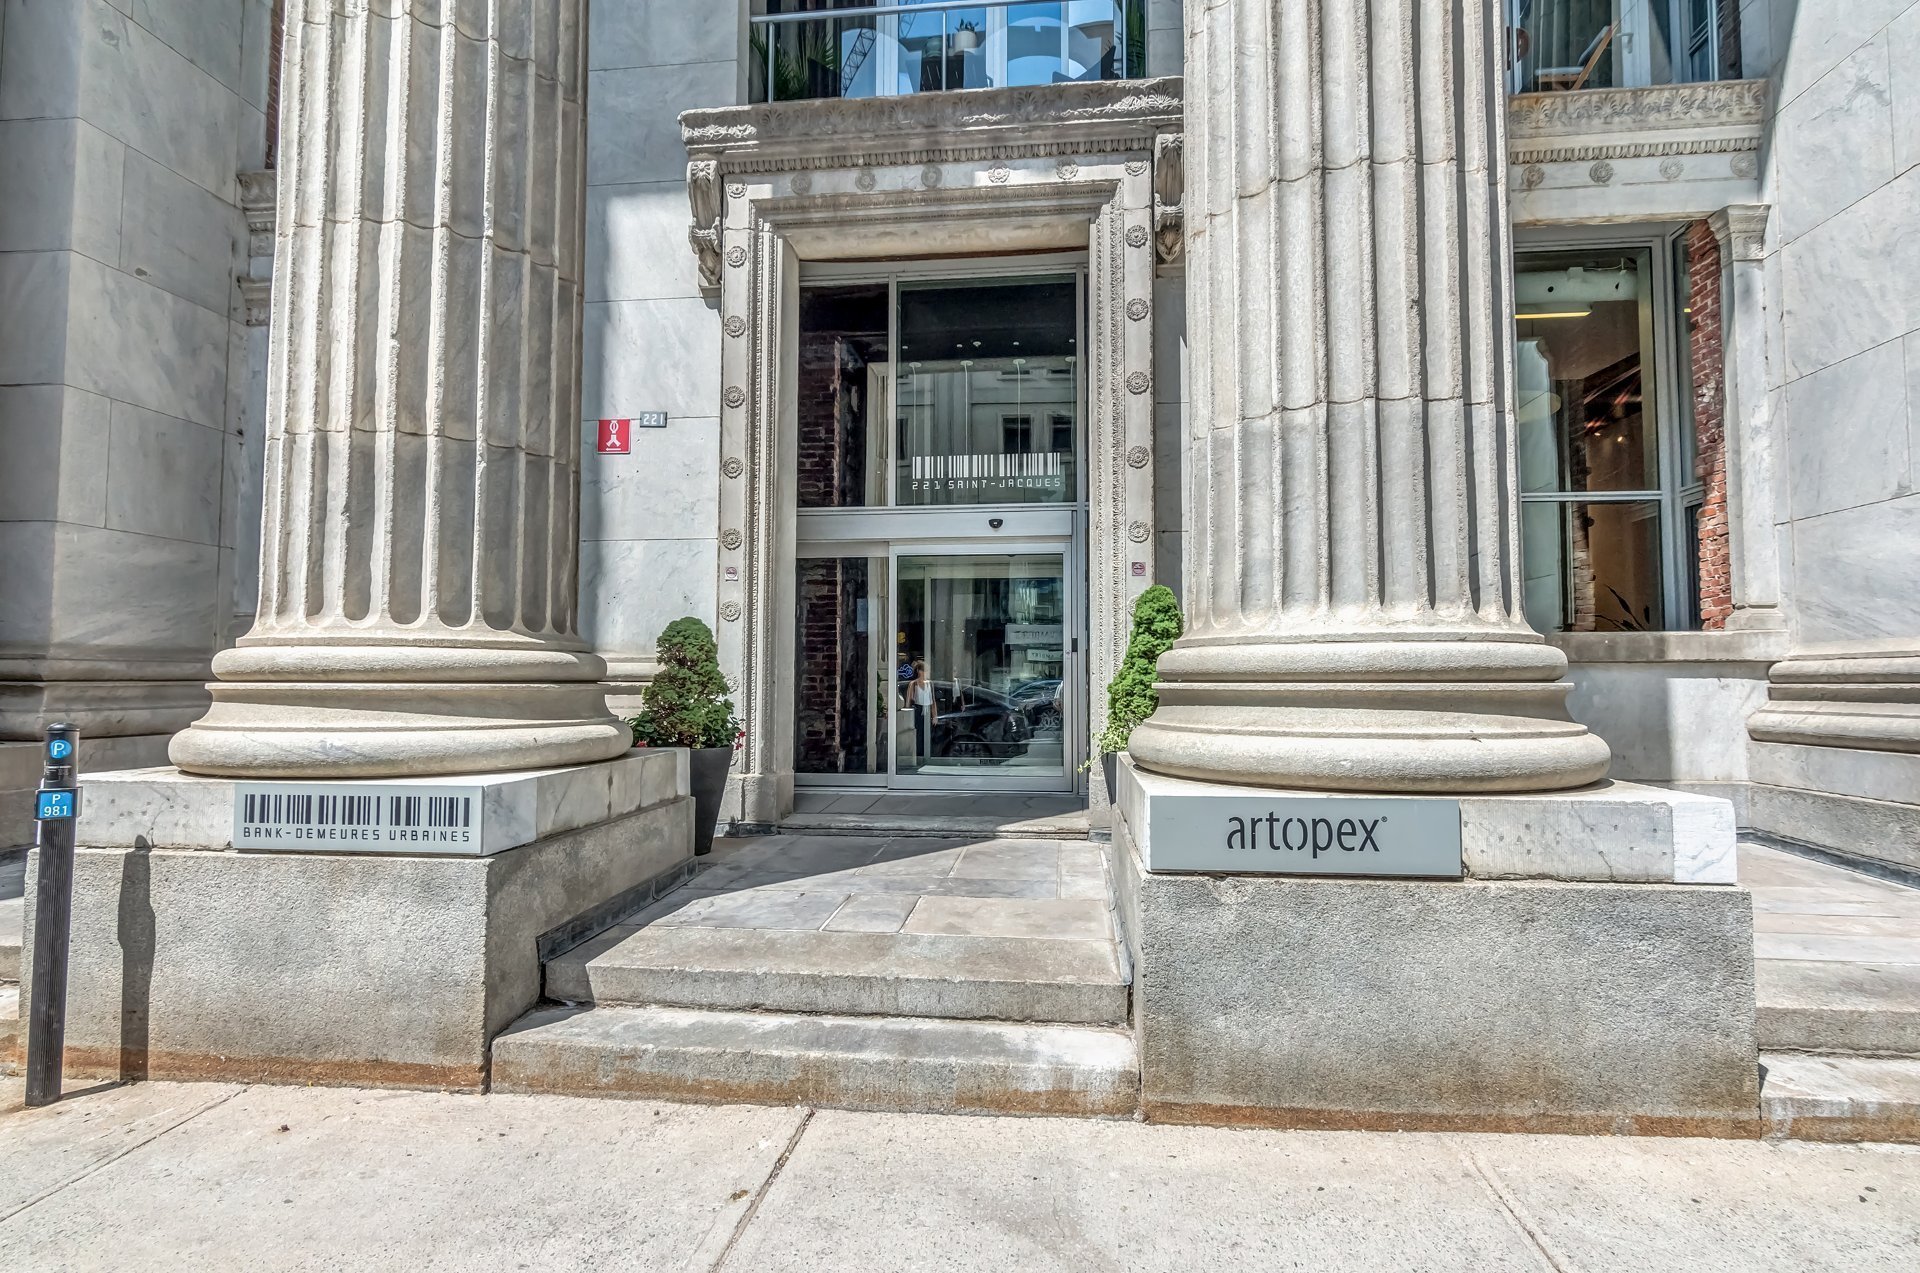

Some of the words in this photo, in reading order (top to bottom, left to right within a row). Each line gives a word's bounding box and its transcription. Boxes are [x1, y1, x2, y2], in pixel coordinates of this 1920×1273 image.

[643, 413, 664, 425] 221
[912, 481, 941, 490] 221
[948, 477, 1061, 489] SAINT-JACQUES
[53, 742, 65, 756] P
[51, 794, 61, 805] P
[43, 805, 68, 817] 981
[243, 826, 380, 841] BANK-DEMEURES
[389, 829, 470, 842] URBAINES
